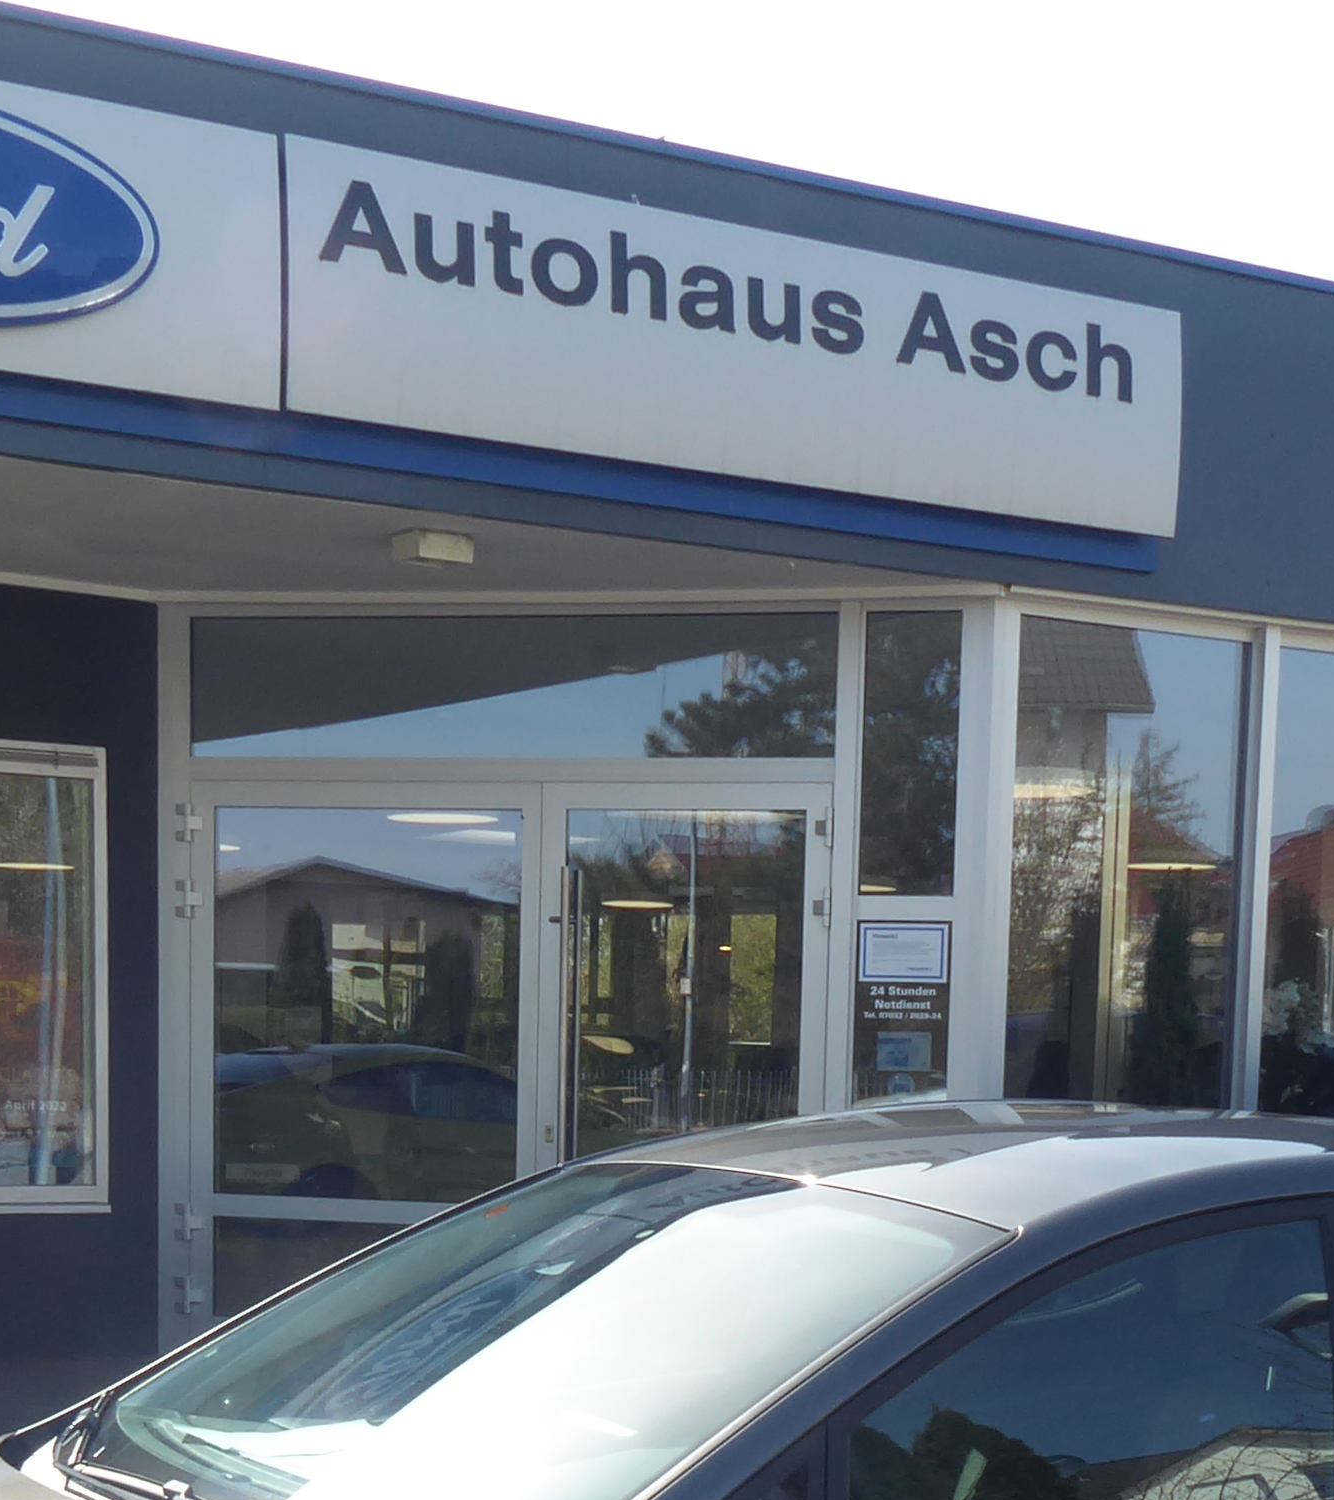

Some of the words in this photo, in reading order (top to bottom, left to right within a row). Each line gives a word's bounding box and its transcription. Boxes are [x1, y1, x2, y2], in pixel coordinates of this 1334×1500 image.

[318, 179, 866, 355] Autohaus
[896, 290, 1135, 404] Asch
[870, 985, 885, 996] 24
[888, 985, 937, 996] Stunden
[874, 999, 931, 1010] Notdienst
